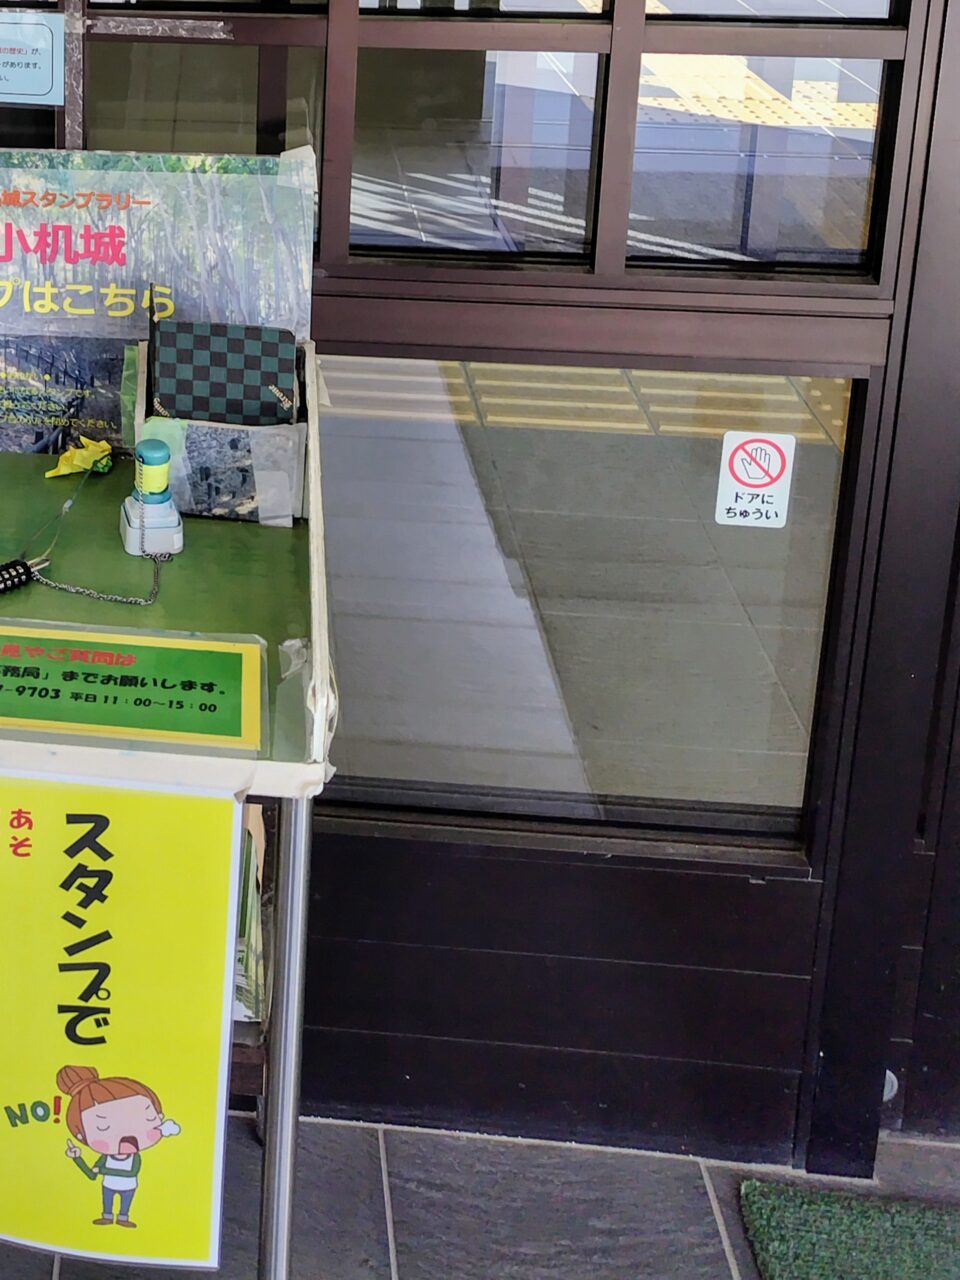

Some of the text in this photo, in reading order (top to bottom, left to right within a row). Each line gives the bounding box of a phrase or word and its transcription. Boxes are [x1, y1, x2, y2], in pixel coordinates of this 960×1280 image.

[725, 506, 779, 520] ちゅうい
[734, 491, 774, 505] ドアに
[8, 808, 35, 858] あそ
[56, 812, 115, 1046] スタンプで
[4, 1096, 63, 1128] NO!
